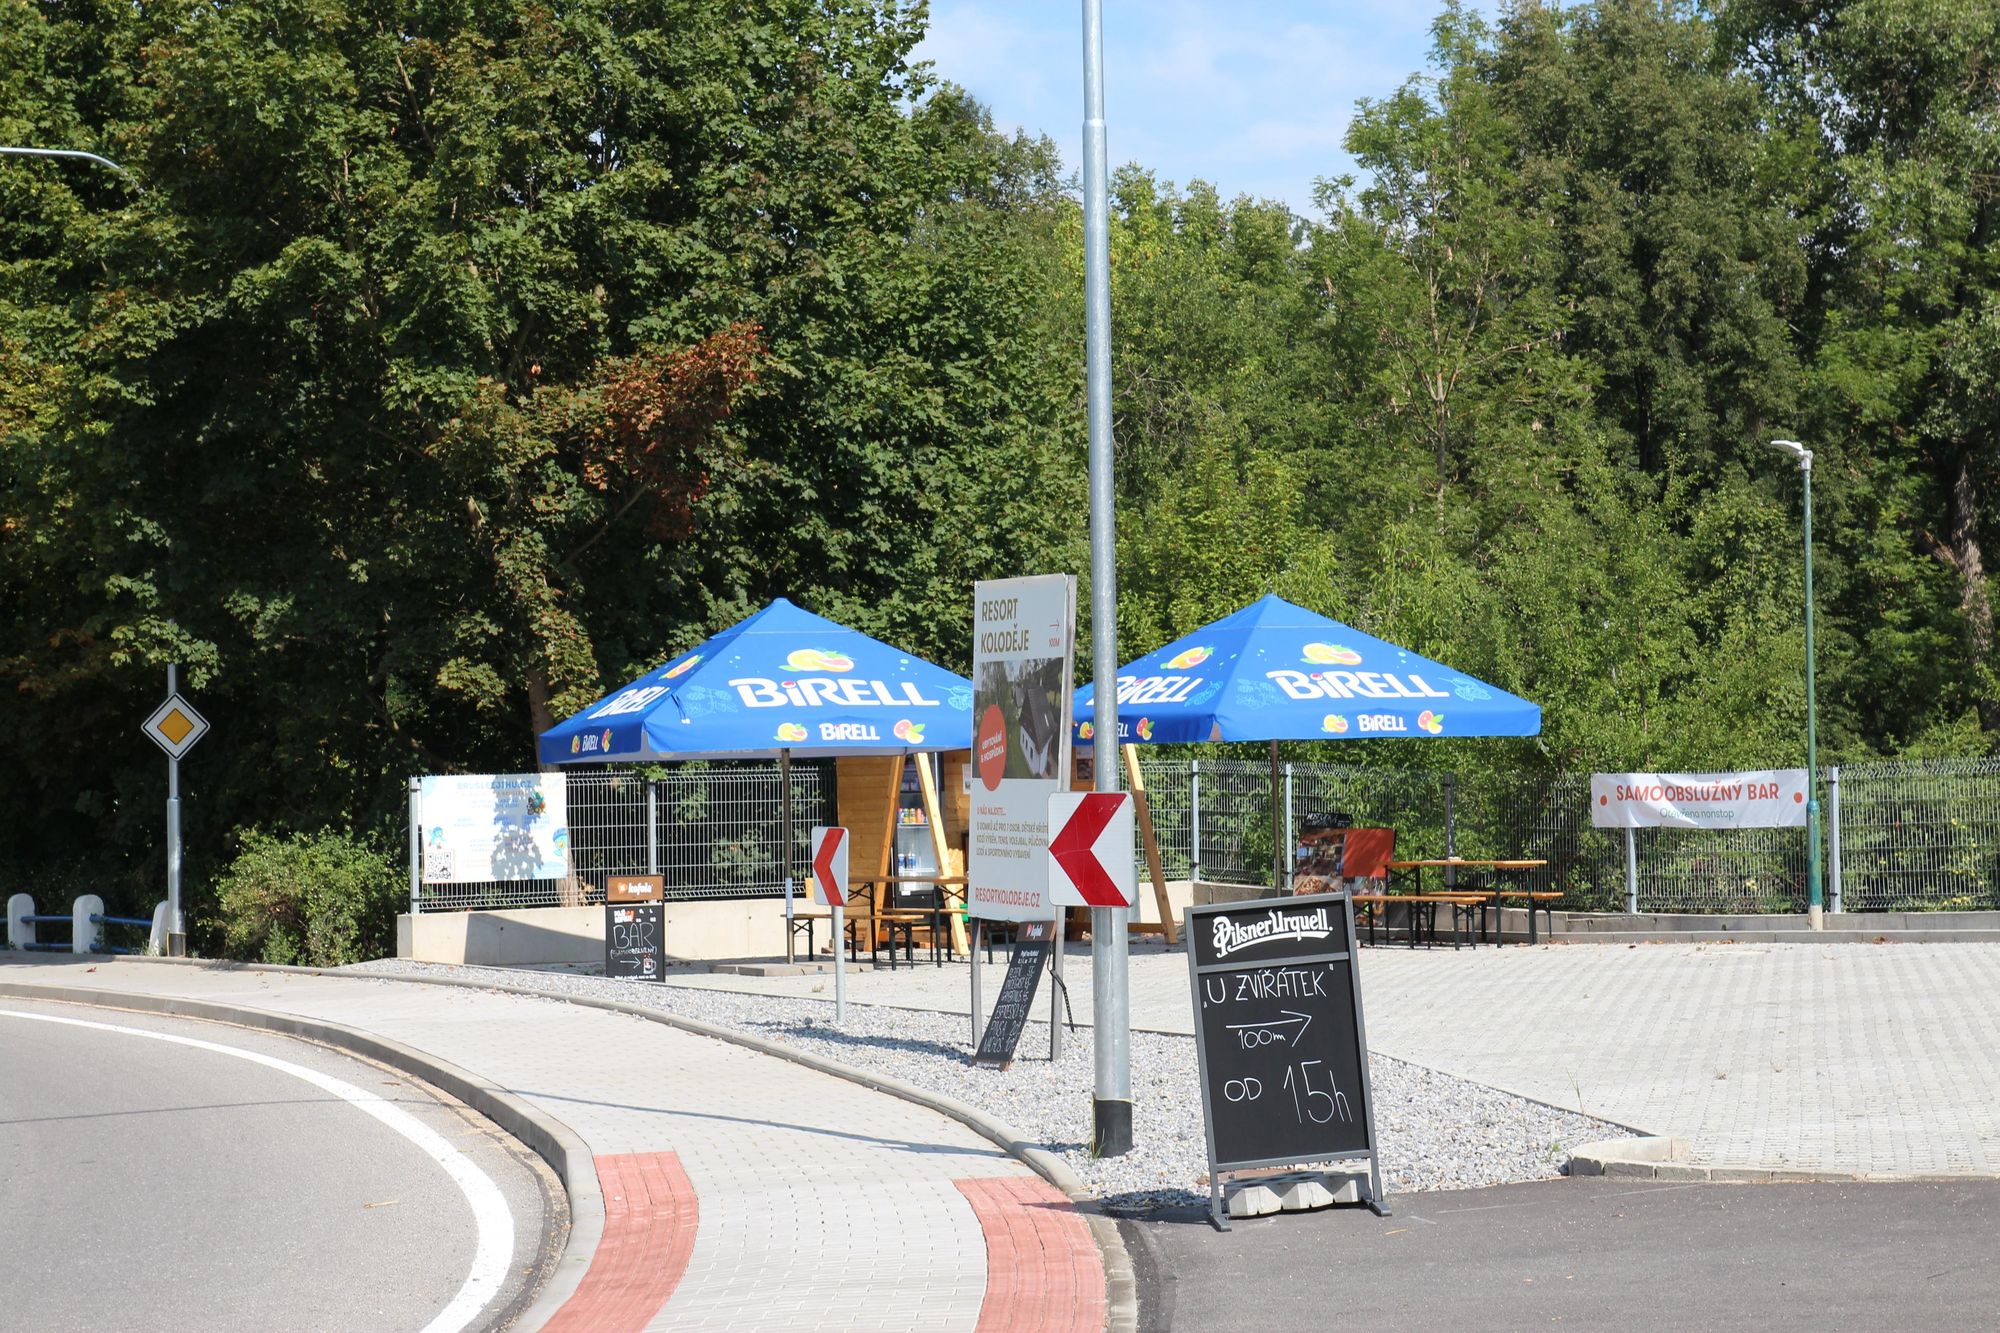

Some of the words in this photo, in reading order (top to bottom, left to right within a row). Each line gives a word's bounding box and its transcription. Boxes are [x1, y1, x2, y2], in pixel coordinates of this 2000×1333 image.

[981, 598, 1019, 622] RESORT
[980, 623, 1030, 654] KOLODĚJE
[1616, 779, 1743, 803] SAMOOBSLUŽNÝ
[1747, 782, 1780, 801] BAR
[1659, 807, 1700, 819] Otevřeno
[1701, 809, 1735, 821] nonstop
[628, 882, 653, 896] kofola
[975, 887, 1041, 908] RESORTKOLODEJE.CZ
[613, 922, 655, 950] BAR
[1212, 912, 1273, 958] Pilsner
[1238, 1028, 1286, 1050] 100m
[1224, 1076, 1263, 1102] OD
[1283, 1059, 1353, 1124] 15h
